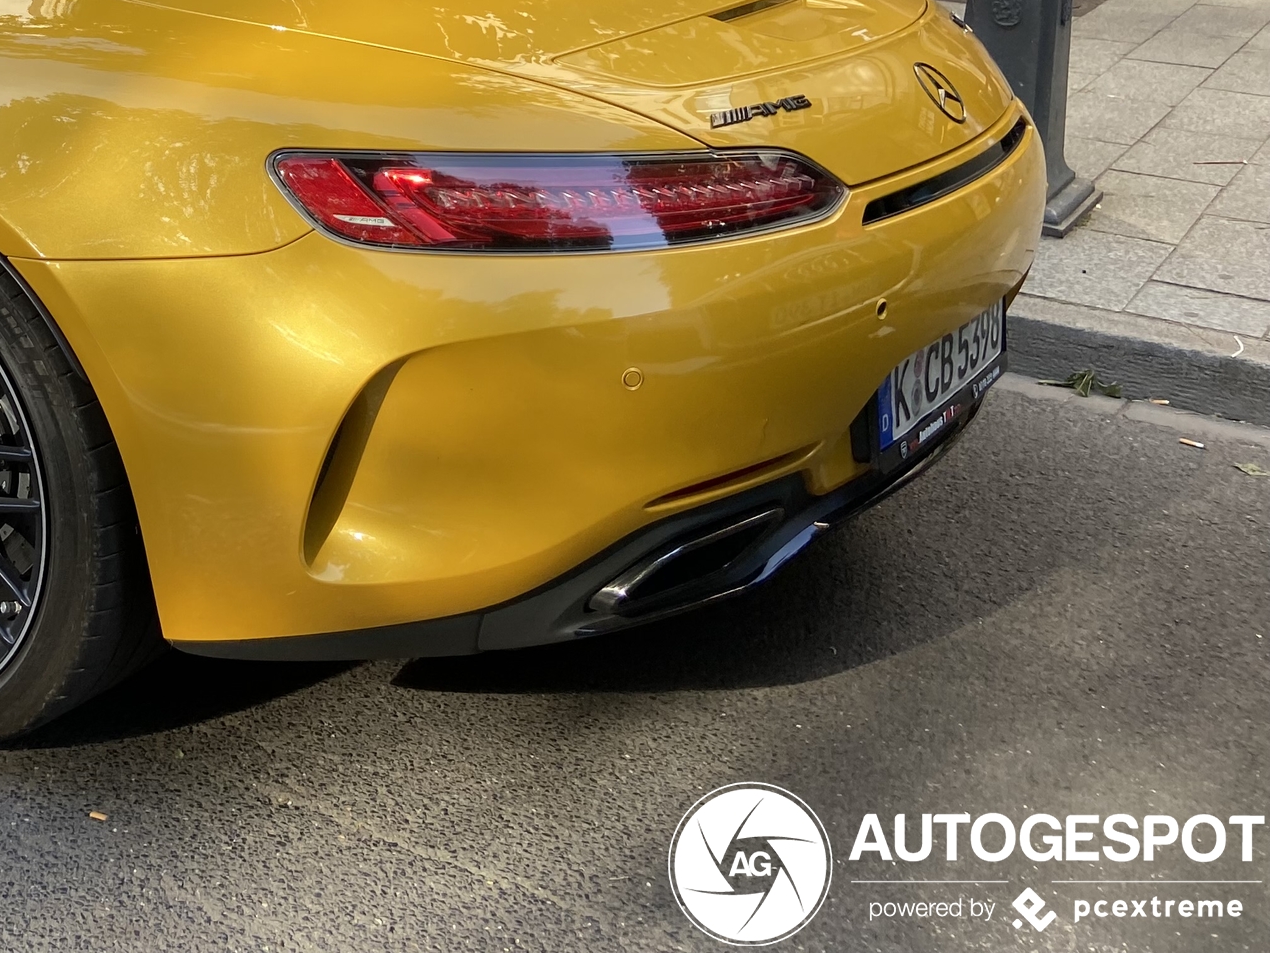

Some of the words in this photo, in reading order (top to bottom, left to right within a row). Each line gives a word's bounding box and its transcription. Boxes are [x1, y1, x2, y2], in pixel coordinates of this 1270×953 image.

[894, 358, 910, 428] K
[925, 333, 954, 403] CB
[958, 300, 1000, 379] 5398
[882, 414, 889, 432] D
